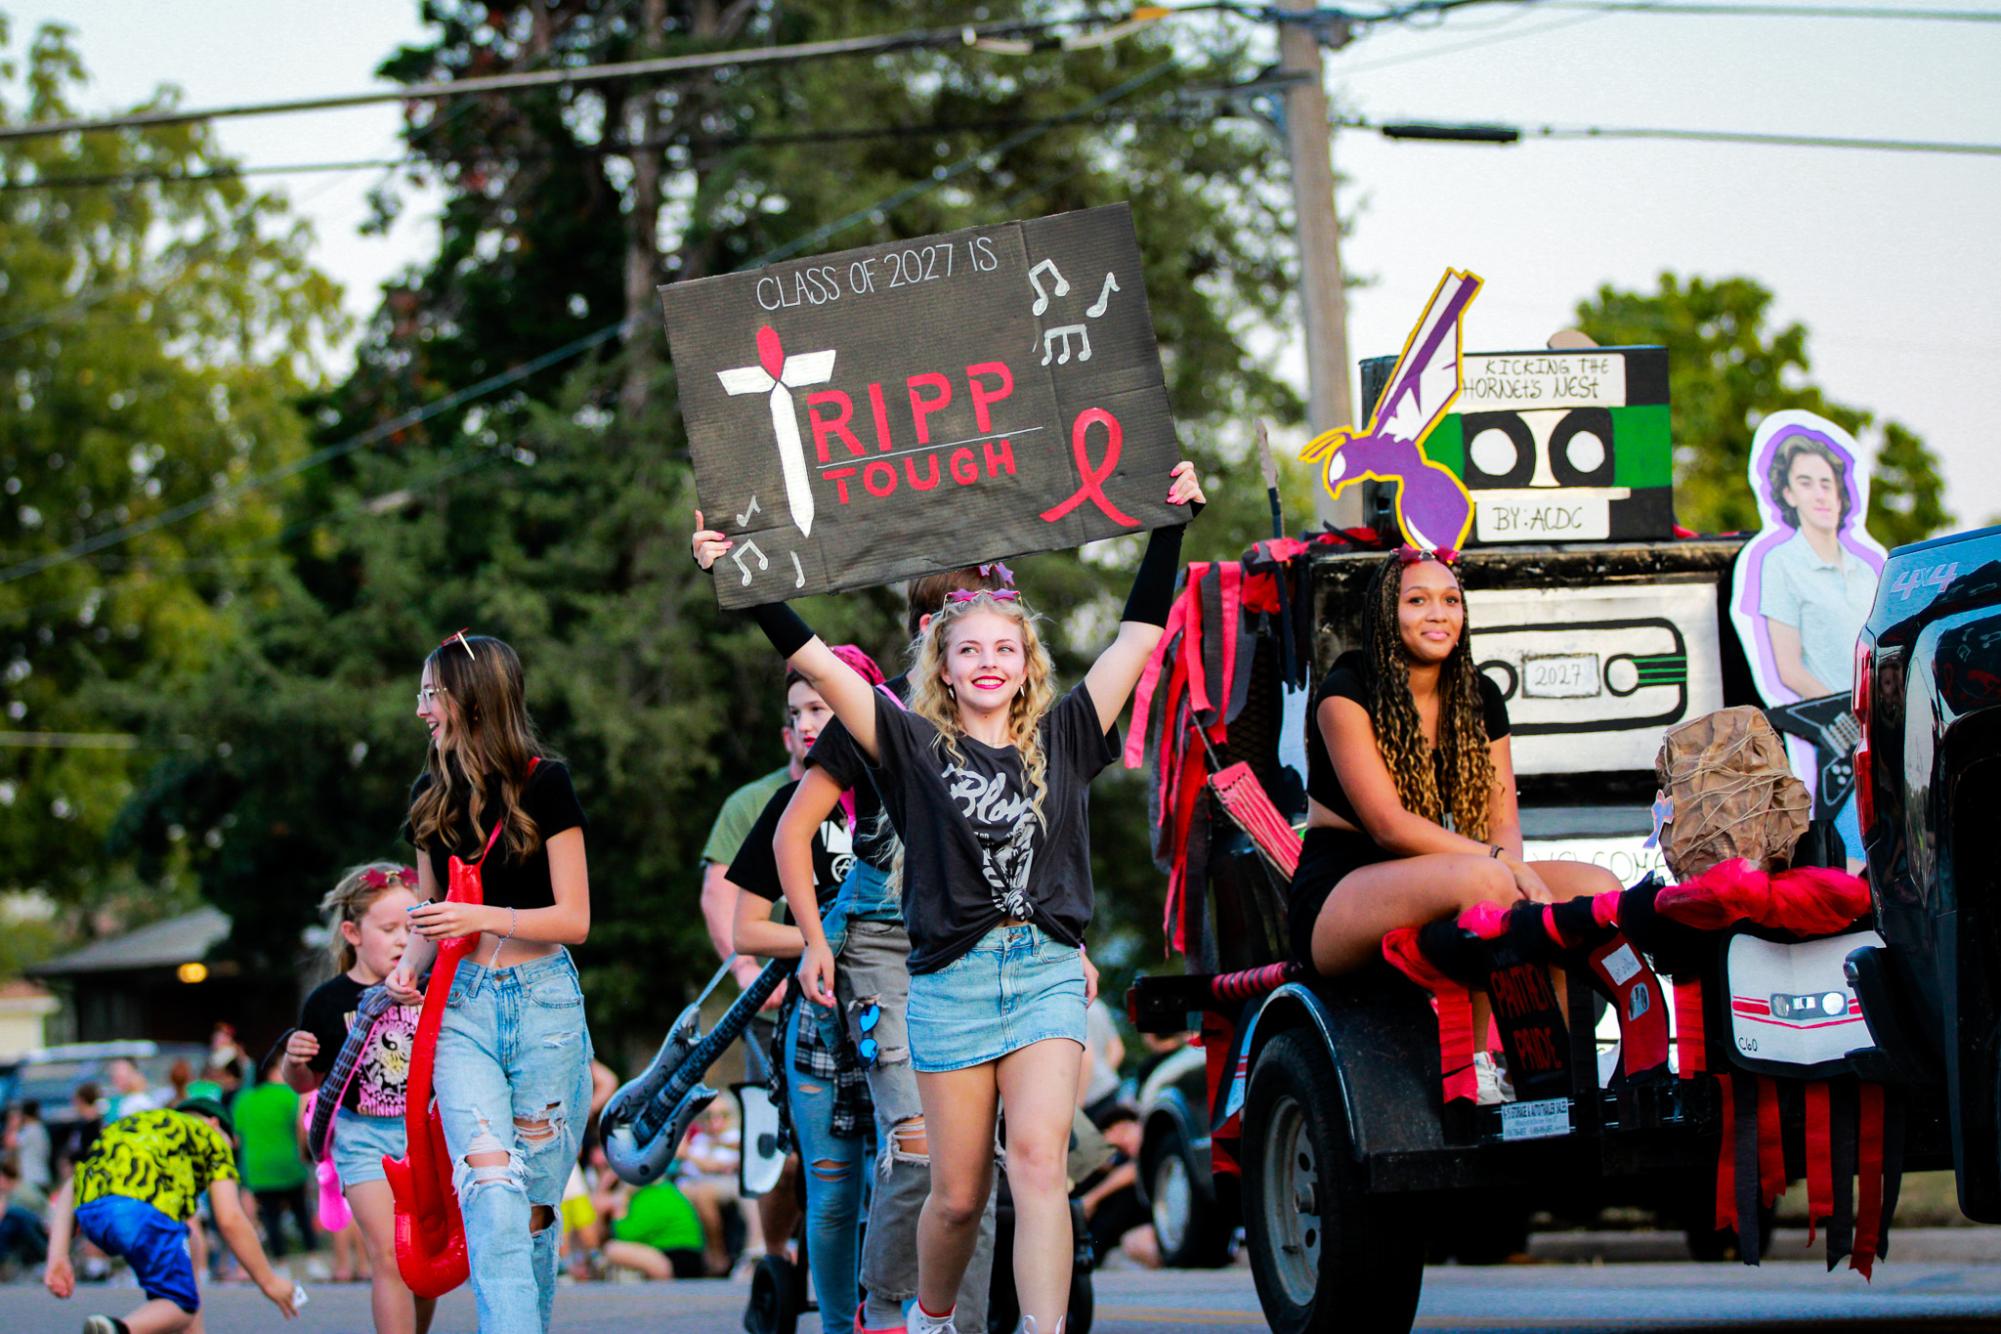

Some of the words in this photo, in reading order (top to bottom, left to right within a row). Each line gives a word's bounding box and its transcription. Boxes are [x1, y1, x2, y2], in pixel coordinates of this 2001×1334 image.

[756, 266, 841, 311] CLASS
[849, 257, 877, 294] OF
[883, 243, 953, 288] 2027
[968, 236, 998, 272] IS
[1484, 358, 1571, 376] KICKING
[1578, 357, 1610, 375] THE
[822, 439, 1017, 505] TOUGH
[1534, 663, 1581, 687] 2027
